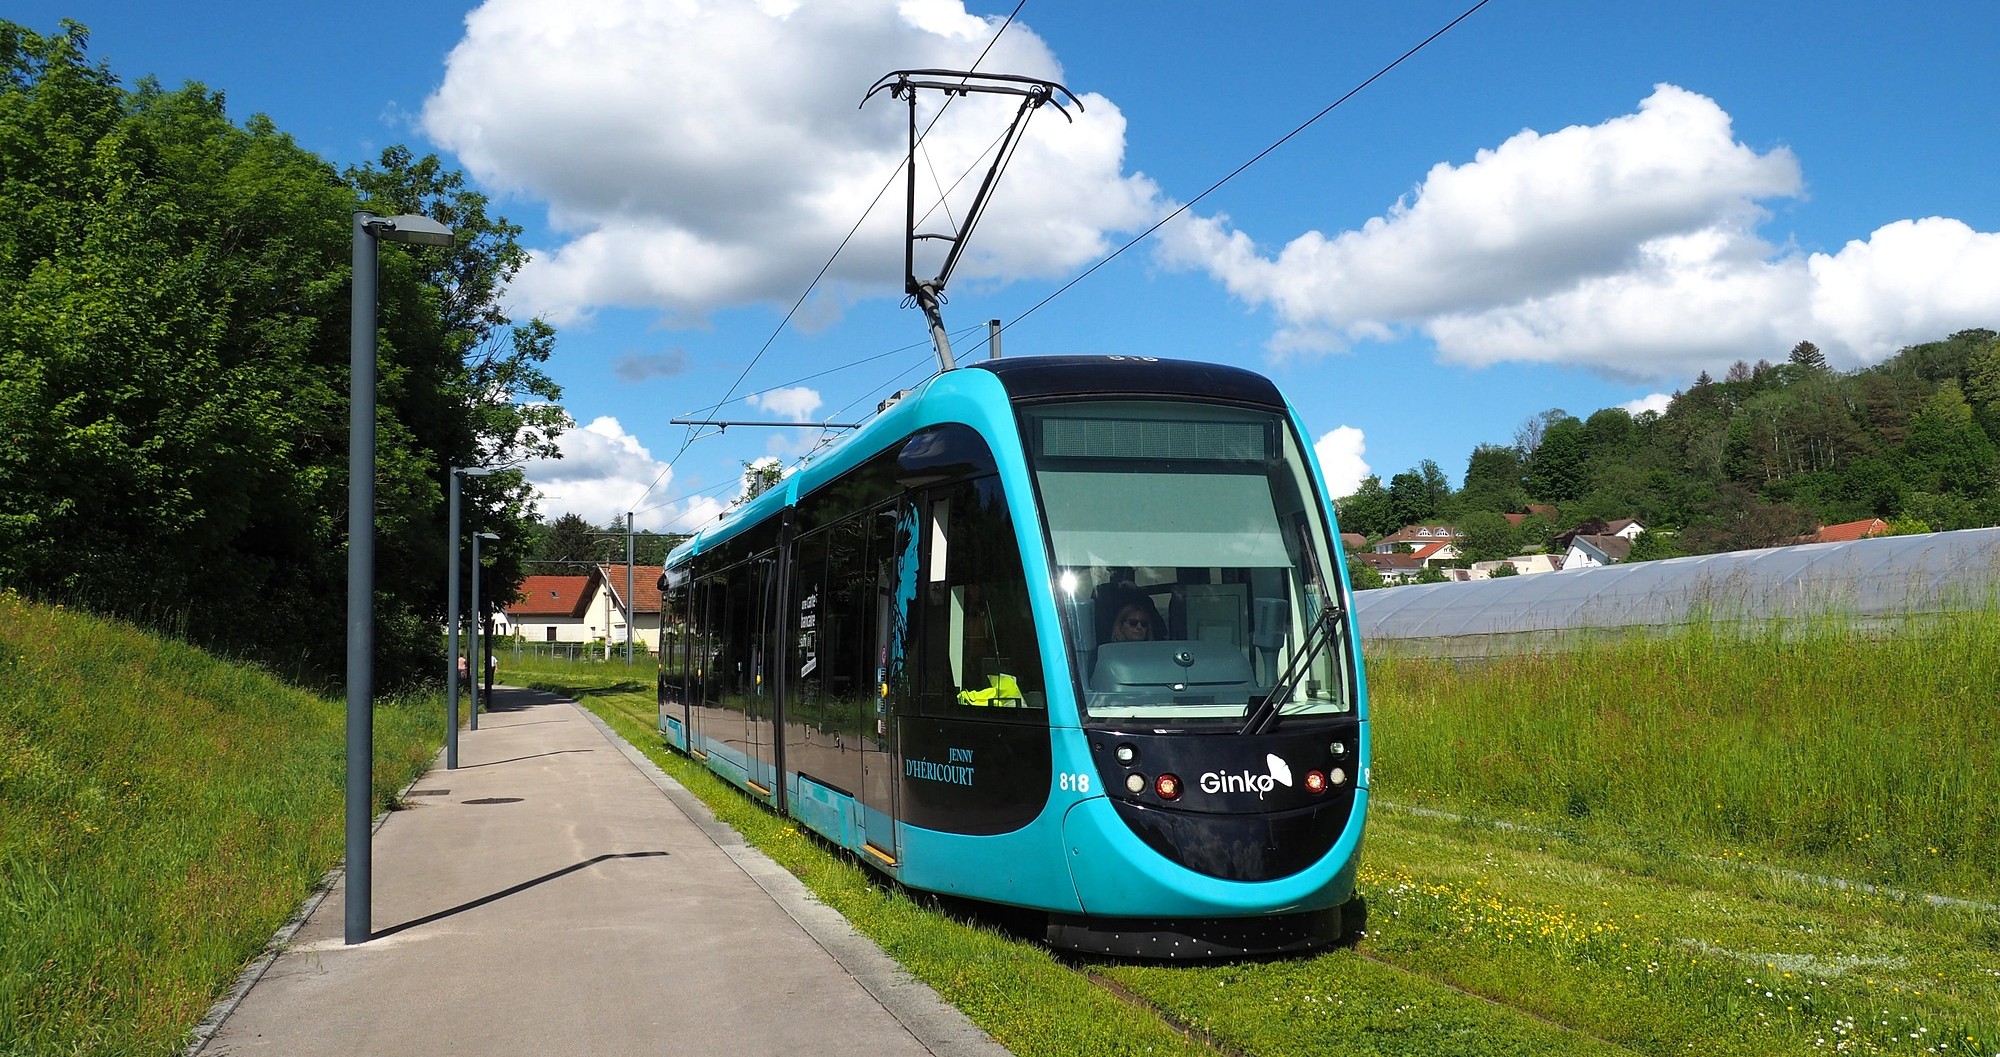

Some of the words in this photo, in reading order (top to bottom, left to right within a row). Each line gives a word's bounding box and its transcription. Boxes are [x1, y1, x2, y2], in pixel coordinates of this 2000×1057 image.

[948, 747, 974, 764] JENNY
[905, 757, 975, 786] D'HÉRICOURT
[1059, 772, 1090, 793] 818
